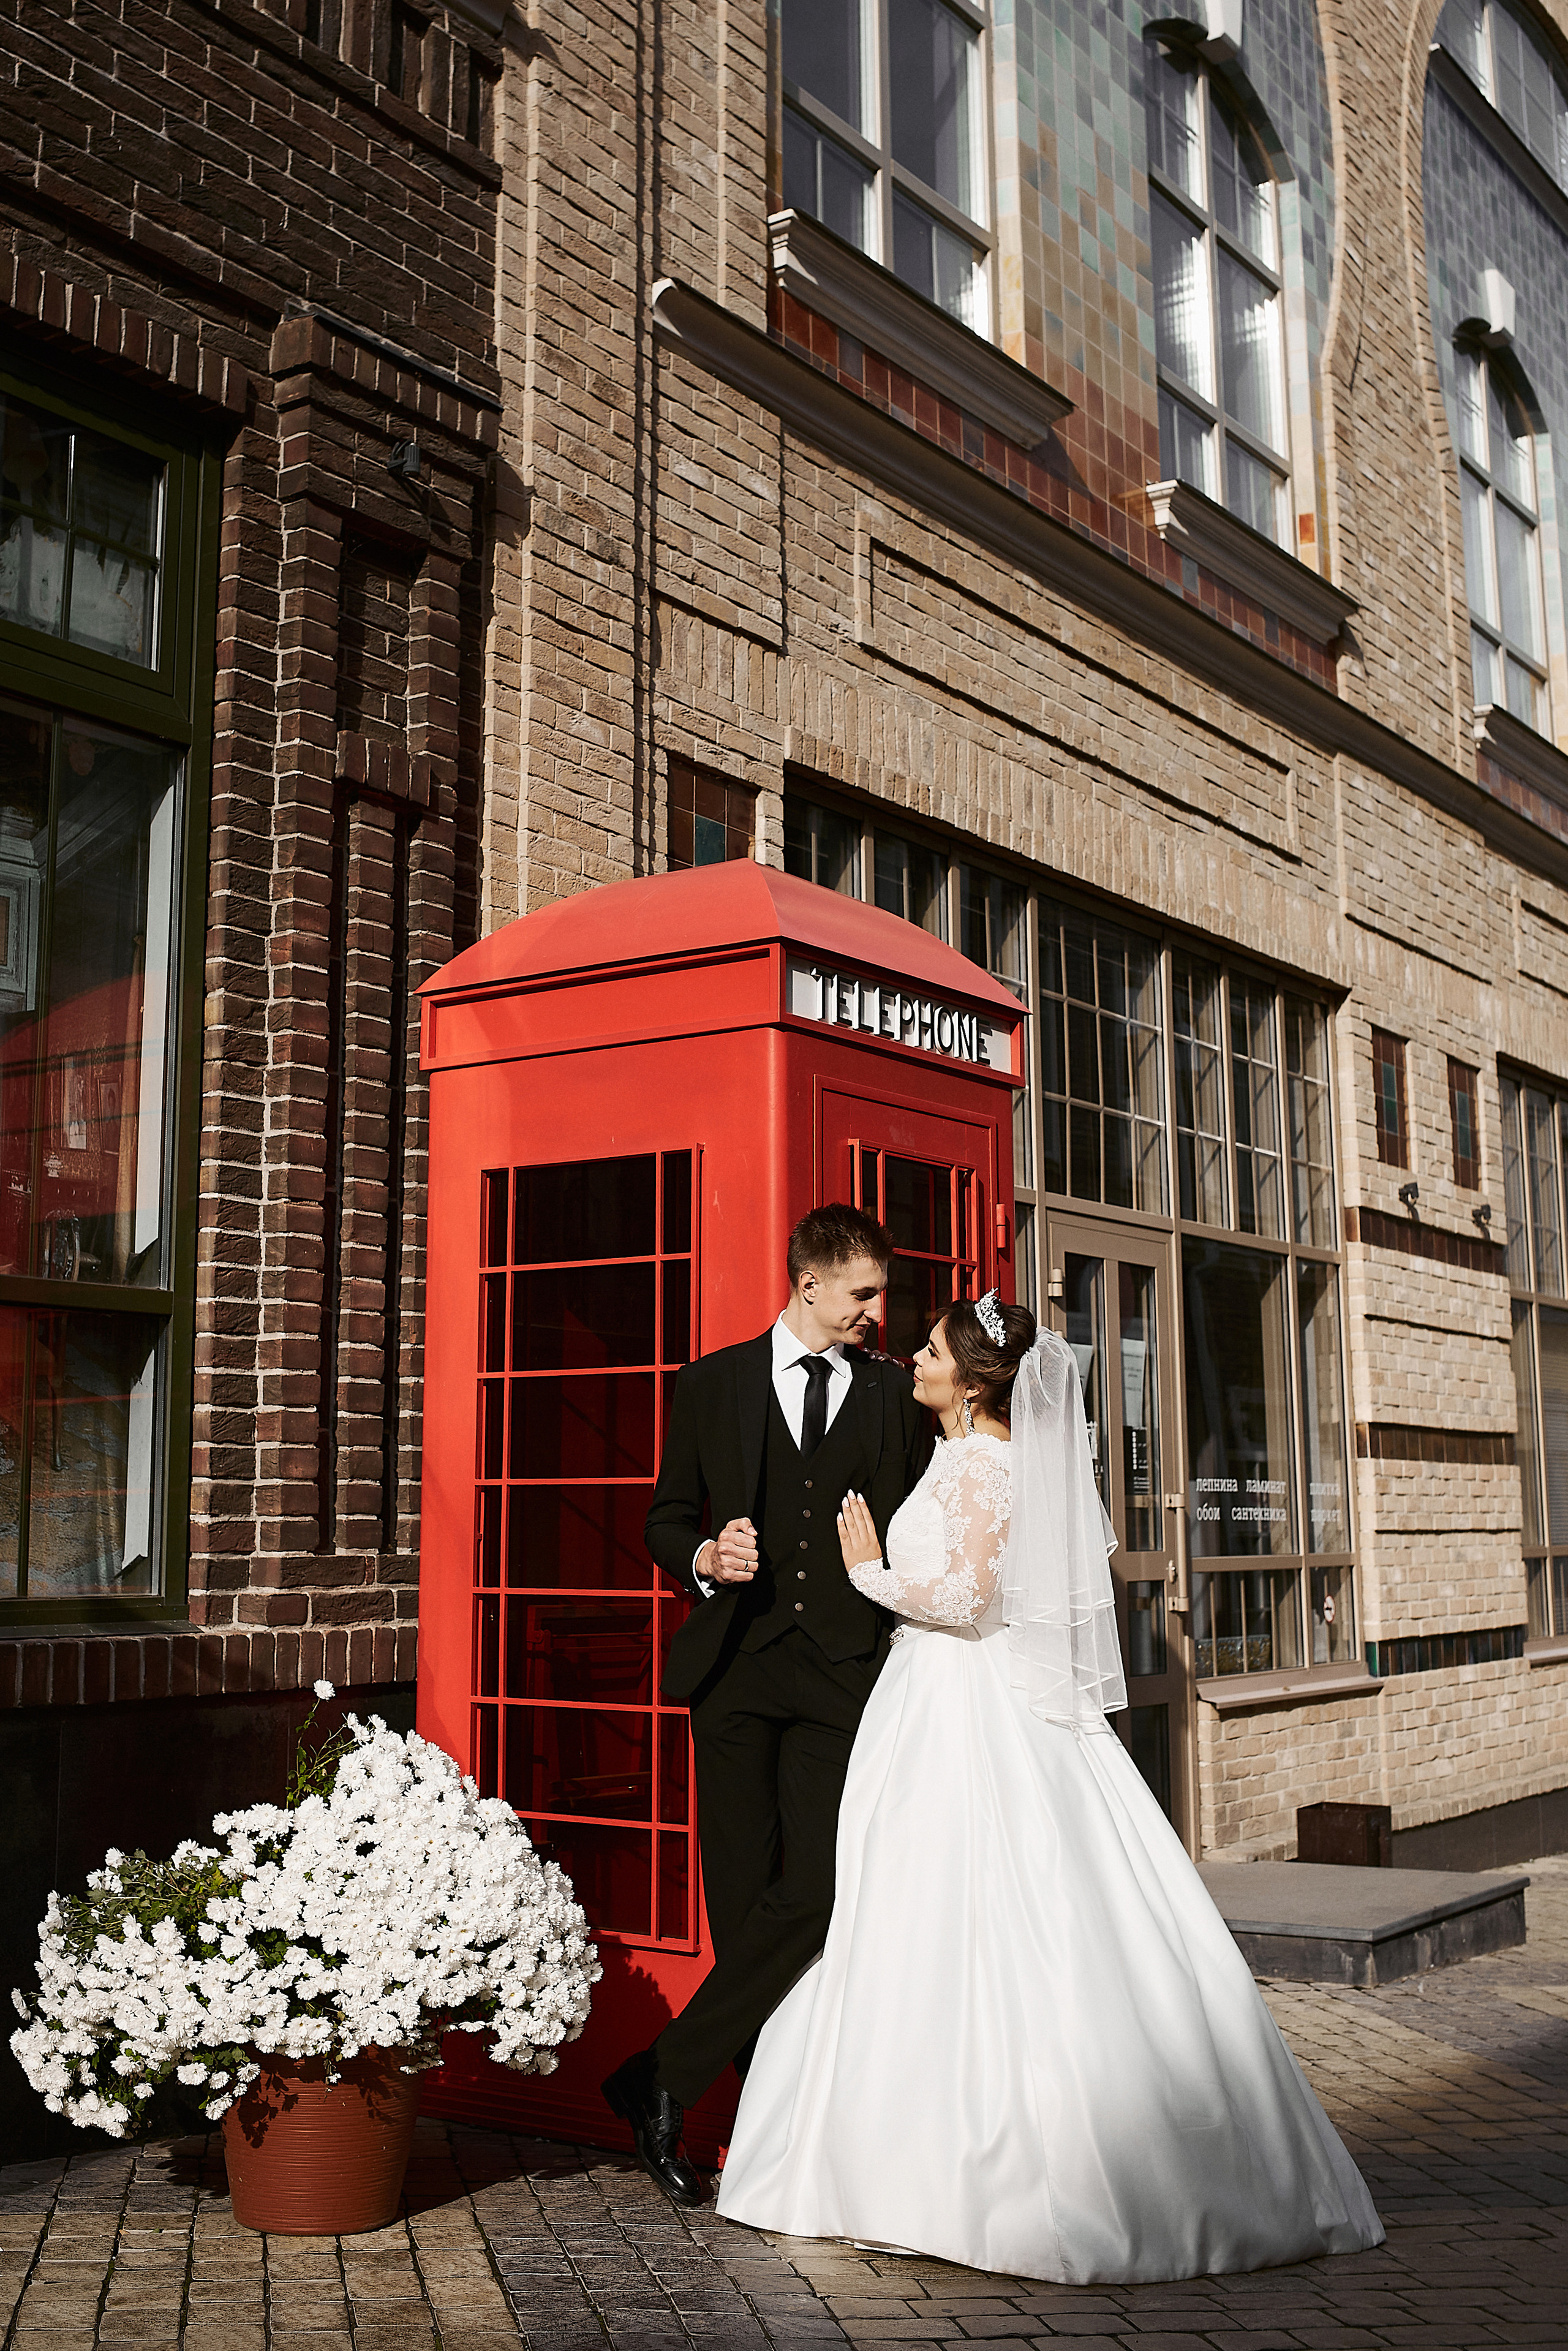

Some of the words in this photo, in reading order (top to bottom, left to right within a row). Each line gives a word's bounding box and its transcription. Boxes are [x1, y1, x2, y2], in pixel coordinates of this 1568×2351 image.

[810, 967, 991, 1064] TELEPHONE
[1196, 1477, 1238, 1492] лепнина
[1246, 1479, 1286, 1494] ламинат
[1196, 1503, 1221, 1521] обои
[1231, 1506, 1287, 1522] сантехника
